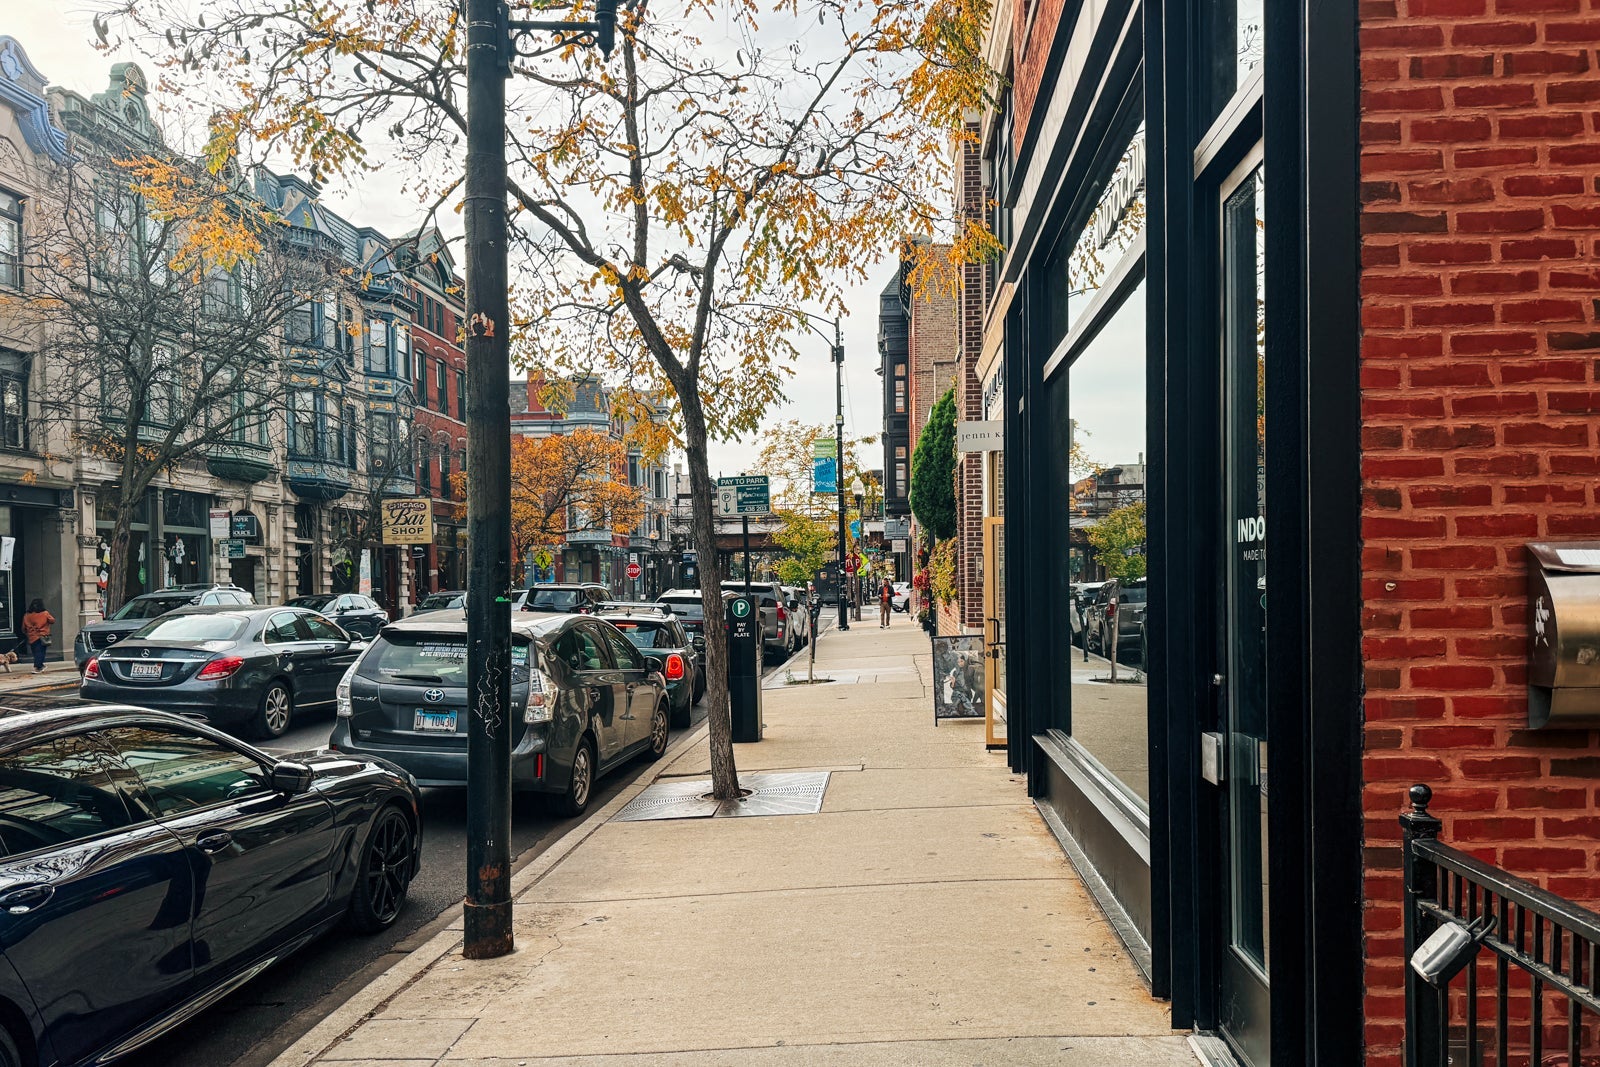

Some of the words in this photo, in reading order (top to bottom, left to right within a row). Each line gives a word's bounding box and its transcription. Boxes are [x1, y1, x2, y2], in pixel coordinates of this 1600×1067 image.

[387, 508, 426, 526] Bar
[1238, 515, 1265, 542] INDO
[1244, 550, 1258, 560] MADE
[738, 602, 745, 614] P
[431, 716, 454, 727] 70430
